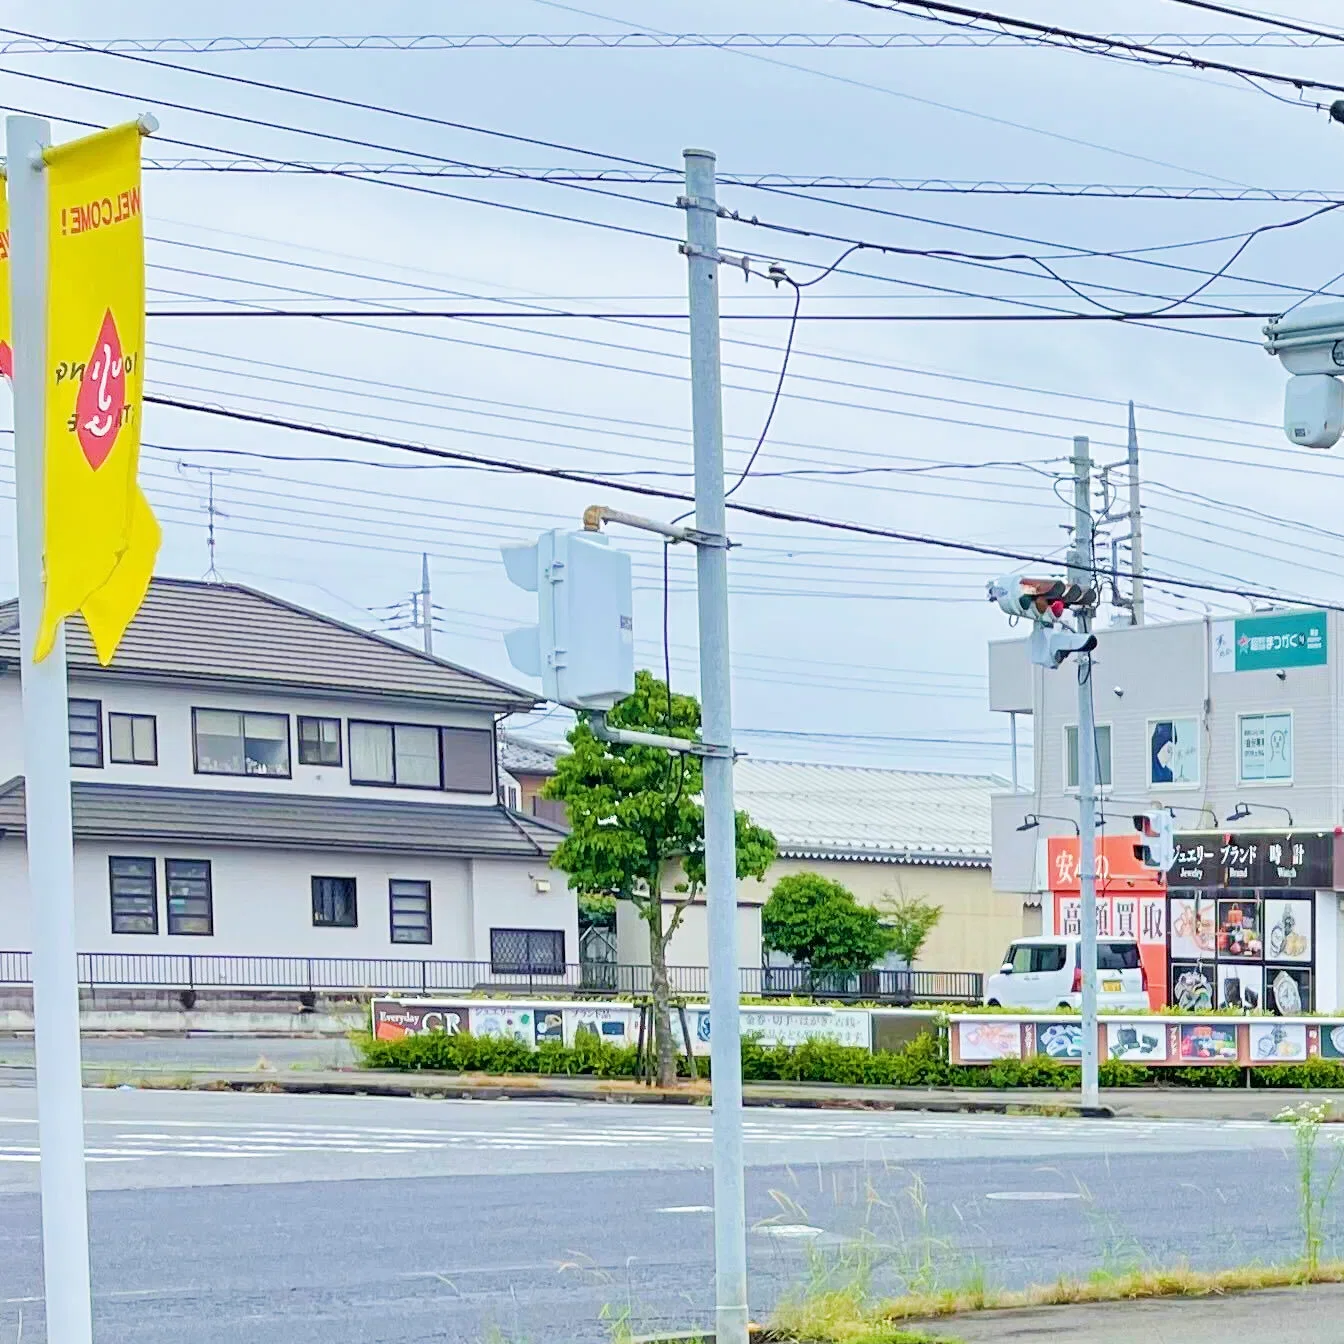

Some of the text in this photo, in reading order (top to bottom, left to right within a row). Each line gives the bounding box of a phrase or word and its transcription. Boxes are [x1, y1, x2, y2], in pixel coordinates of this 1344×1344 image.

[1056, 850, 1109, 884] 安の
[1221, 844, 1257, 865] ブランド
[380, 1011, 461, 1037] Everyday GR
